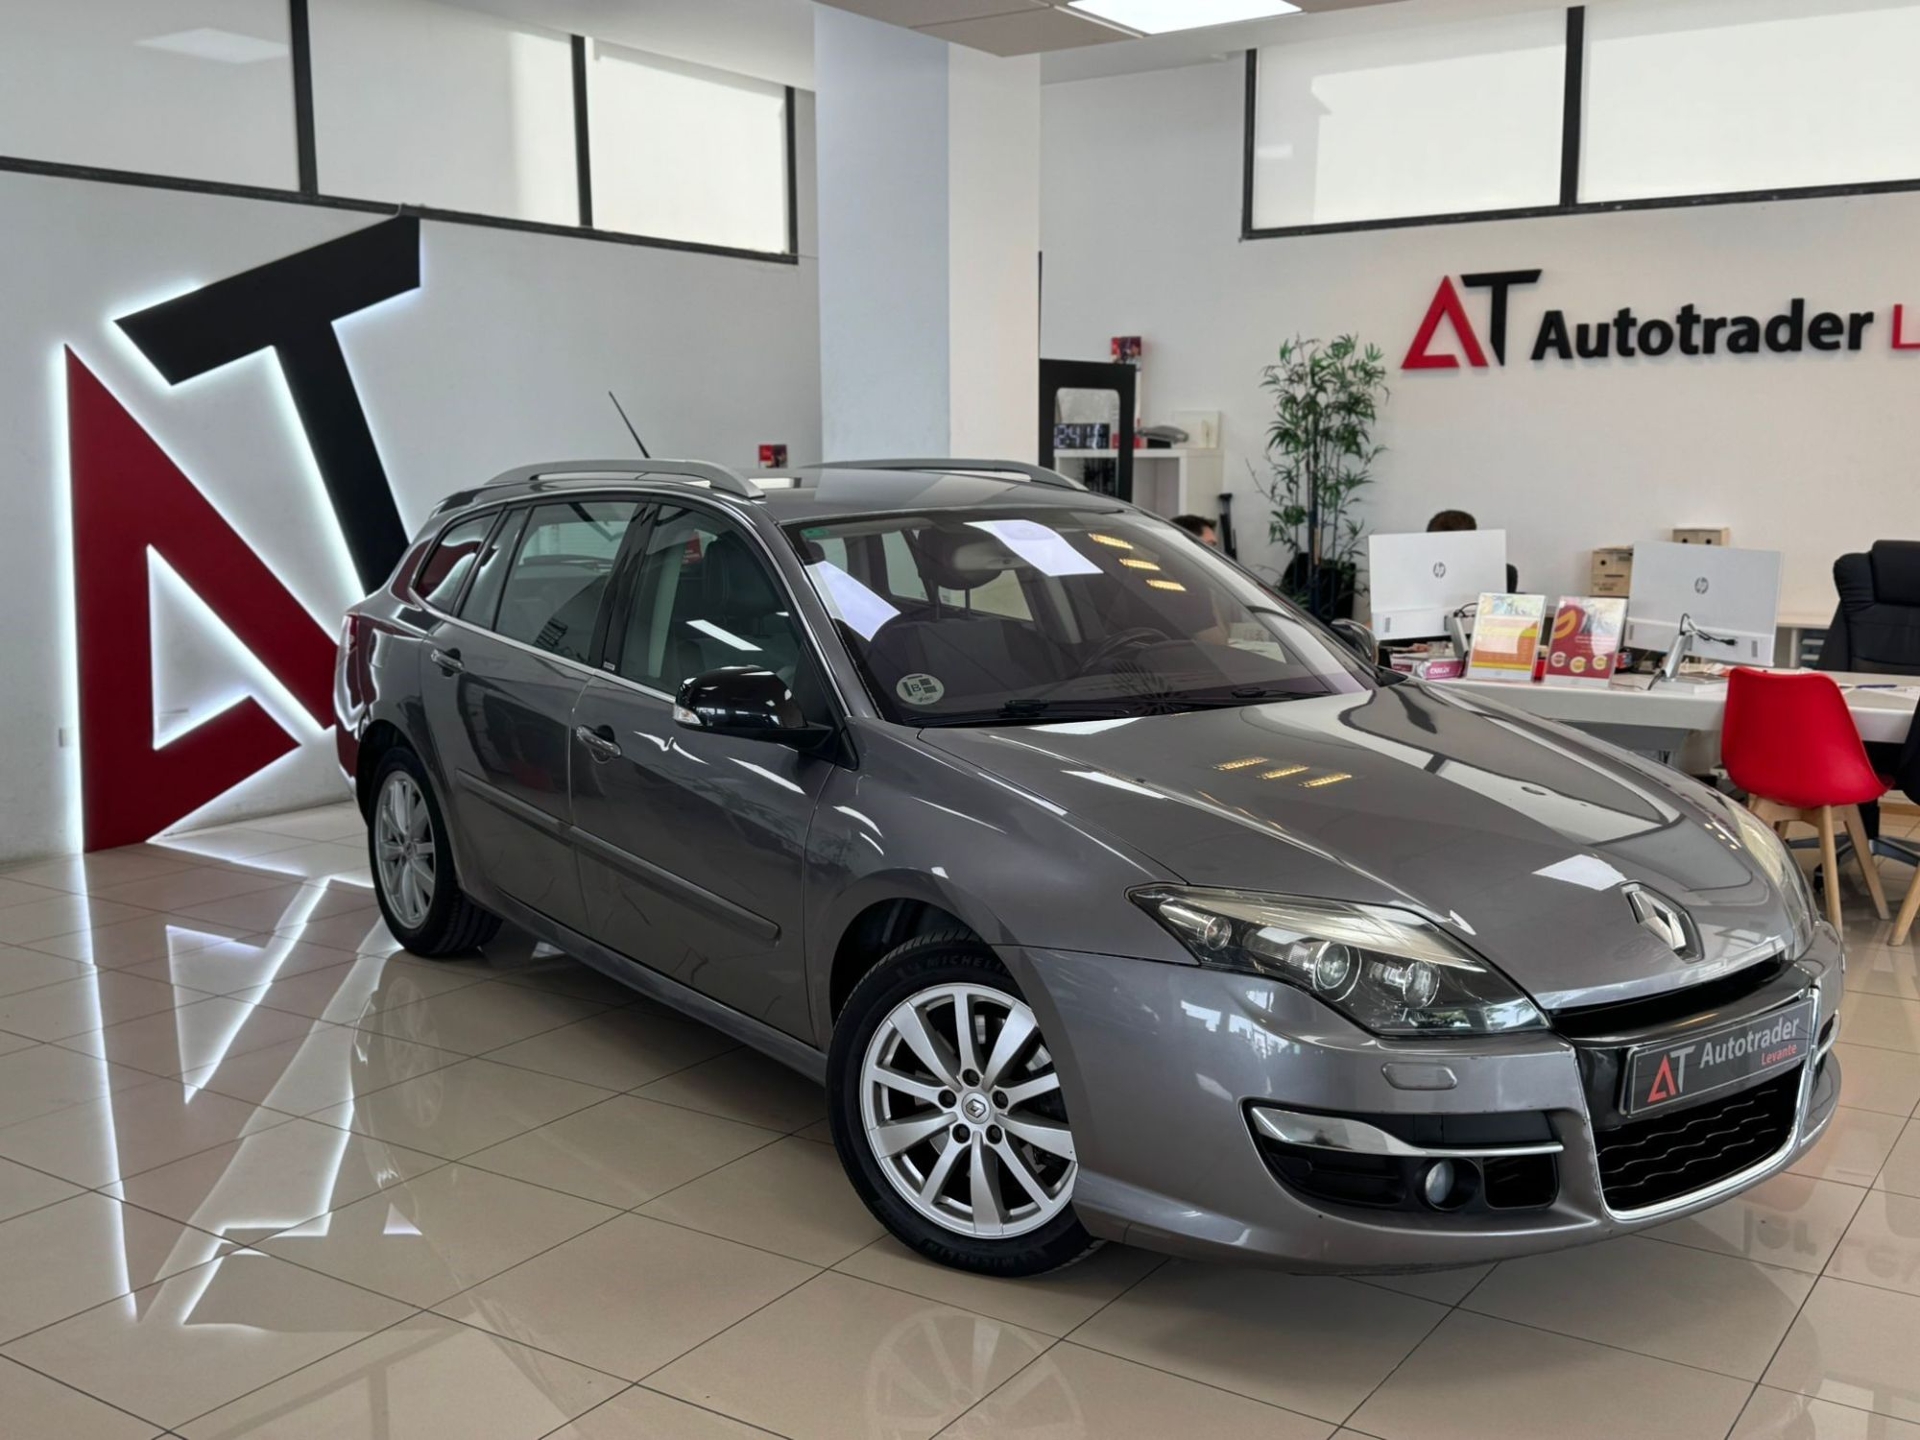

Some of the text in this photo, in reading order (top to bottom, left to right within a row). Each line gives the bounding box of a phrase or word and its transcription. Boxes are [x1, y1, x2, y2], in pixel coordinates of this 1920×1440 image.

[1400, 268, 1543, 370] AT
[1530, 297, 1875, 360] Autotrader
[1647, 1016, 1800, 1104] AT Autotrader
[1760, 1042, 1799, 1067] Levante
